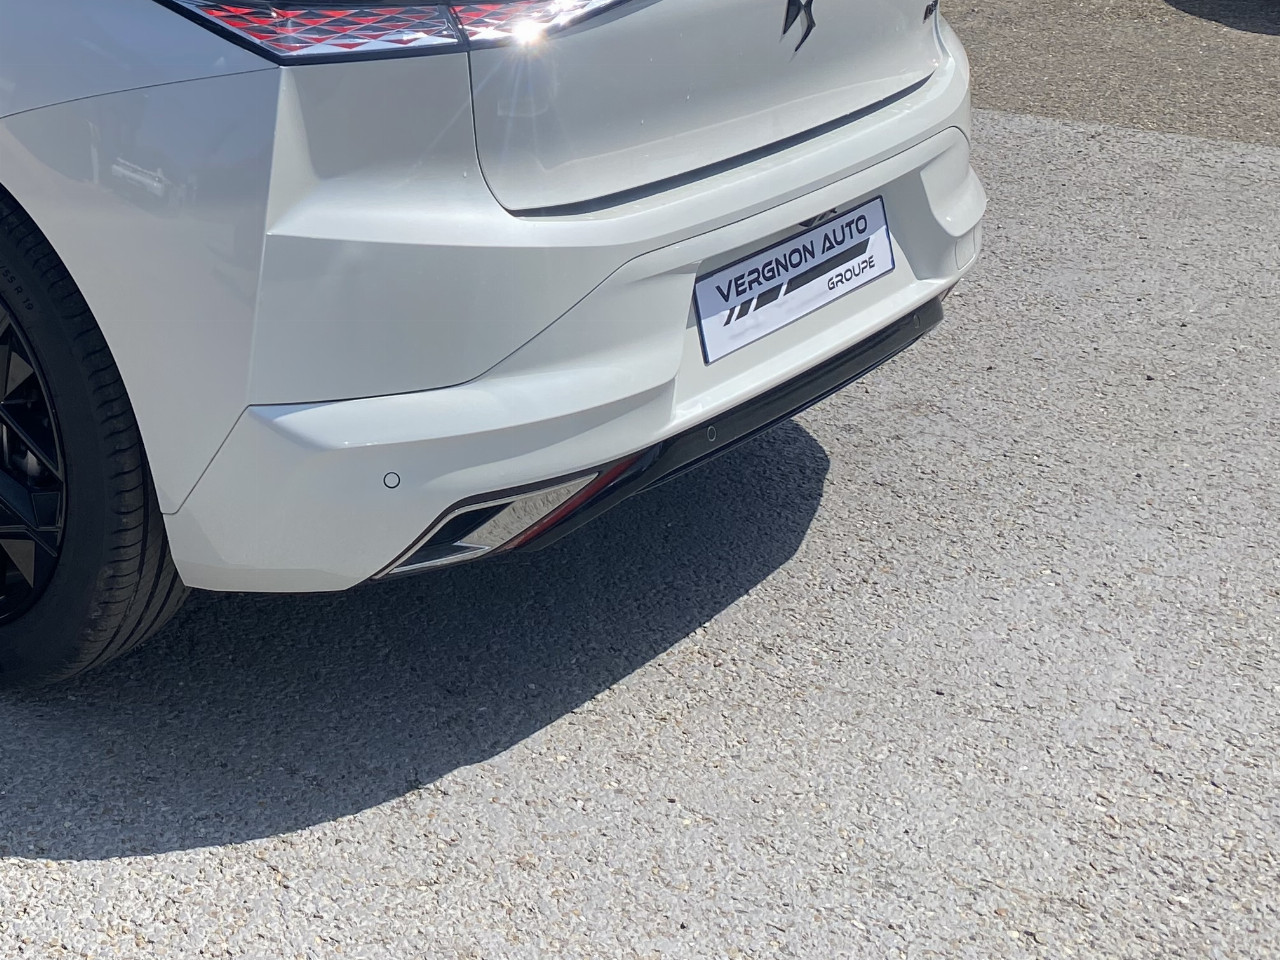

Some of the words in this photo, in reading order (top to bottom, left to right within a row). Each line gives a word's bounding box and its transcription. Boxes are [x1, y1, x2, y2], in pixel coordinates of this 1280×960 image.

[715, 239, 816, 303] VERGNON
[822, 214, 868, 255] AUTO
[827, 254, 876, 291] GROUPE
